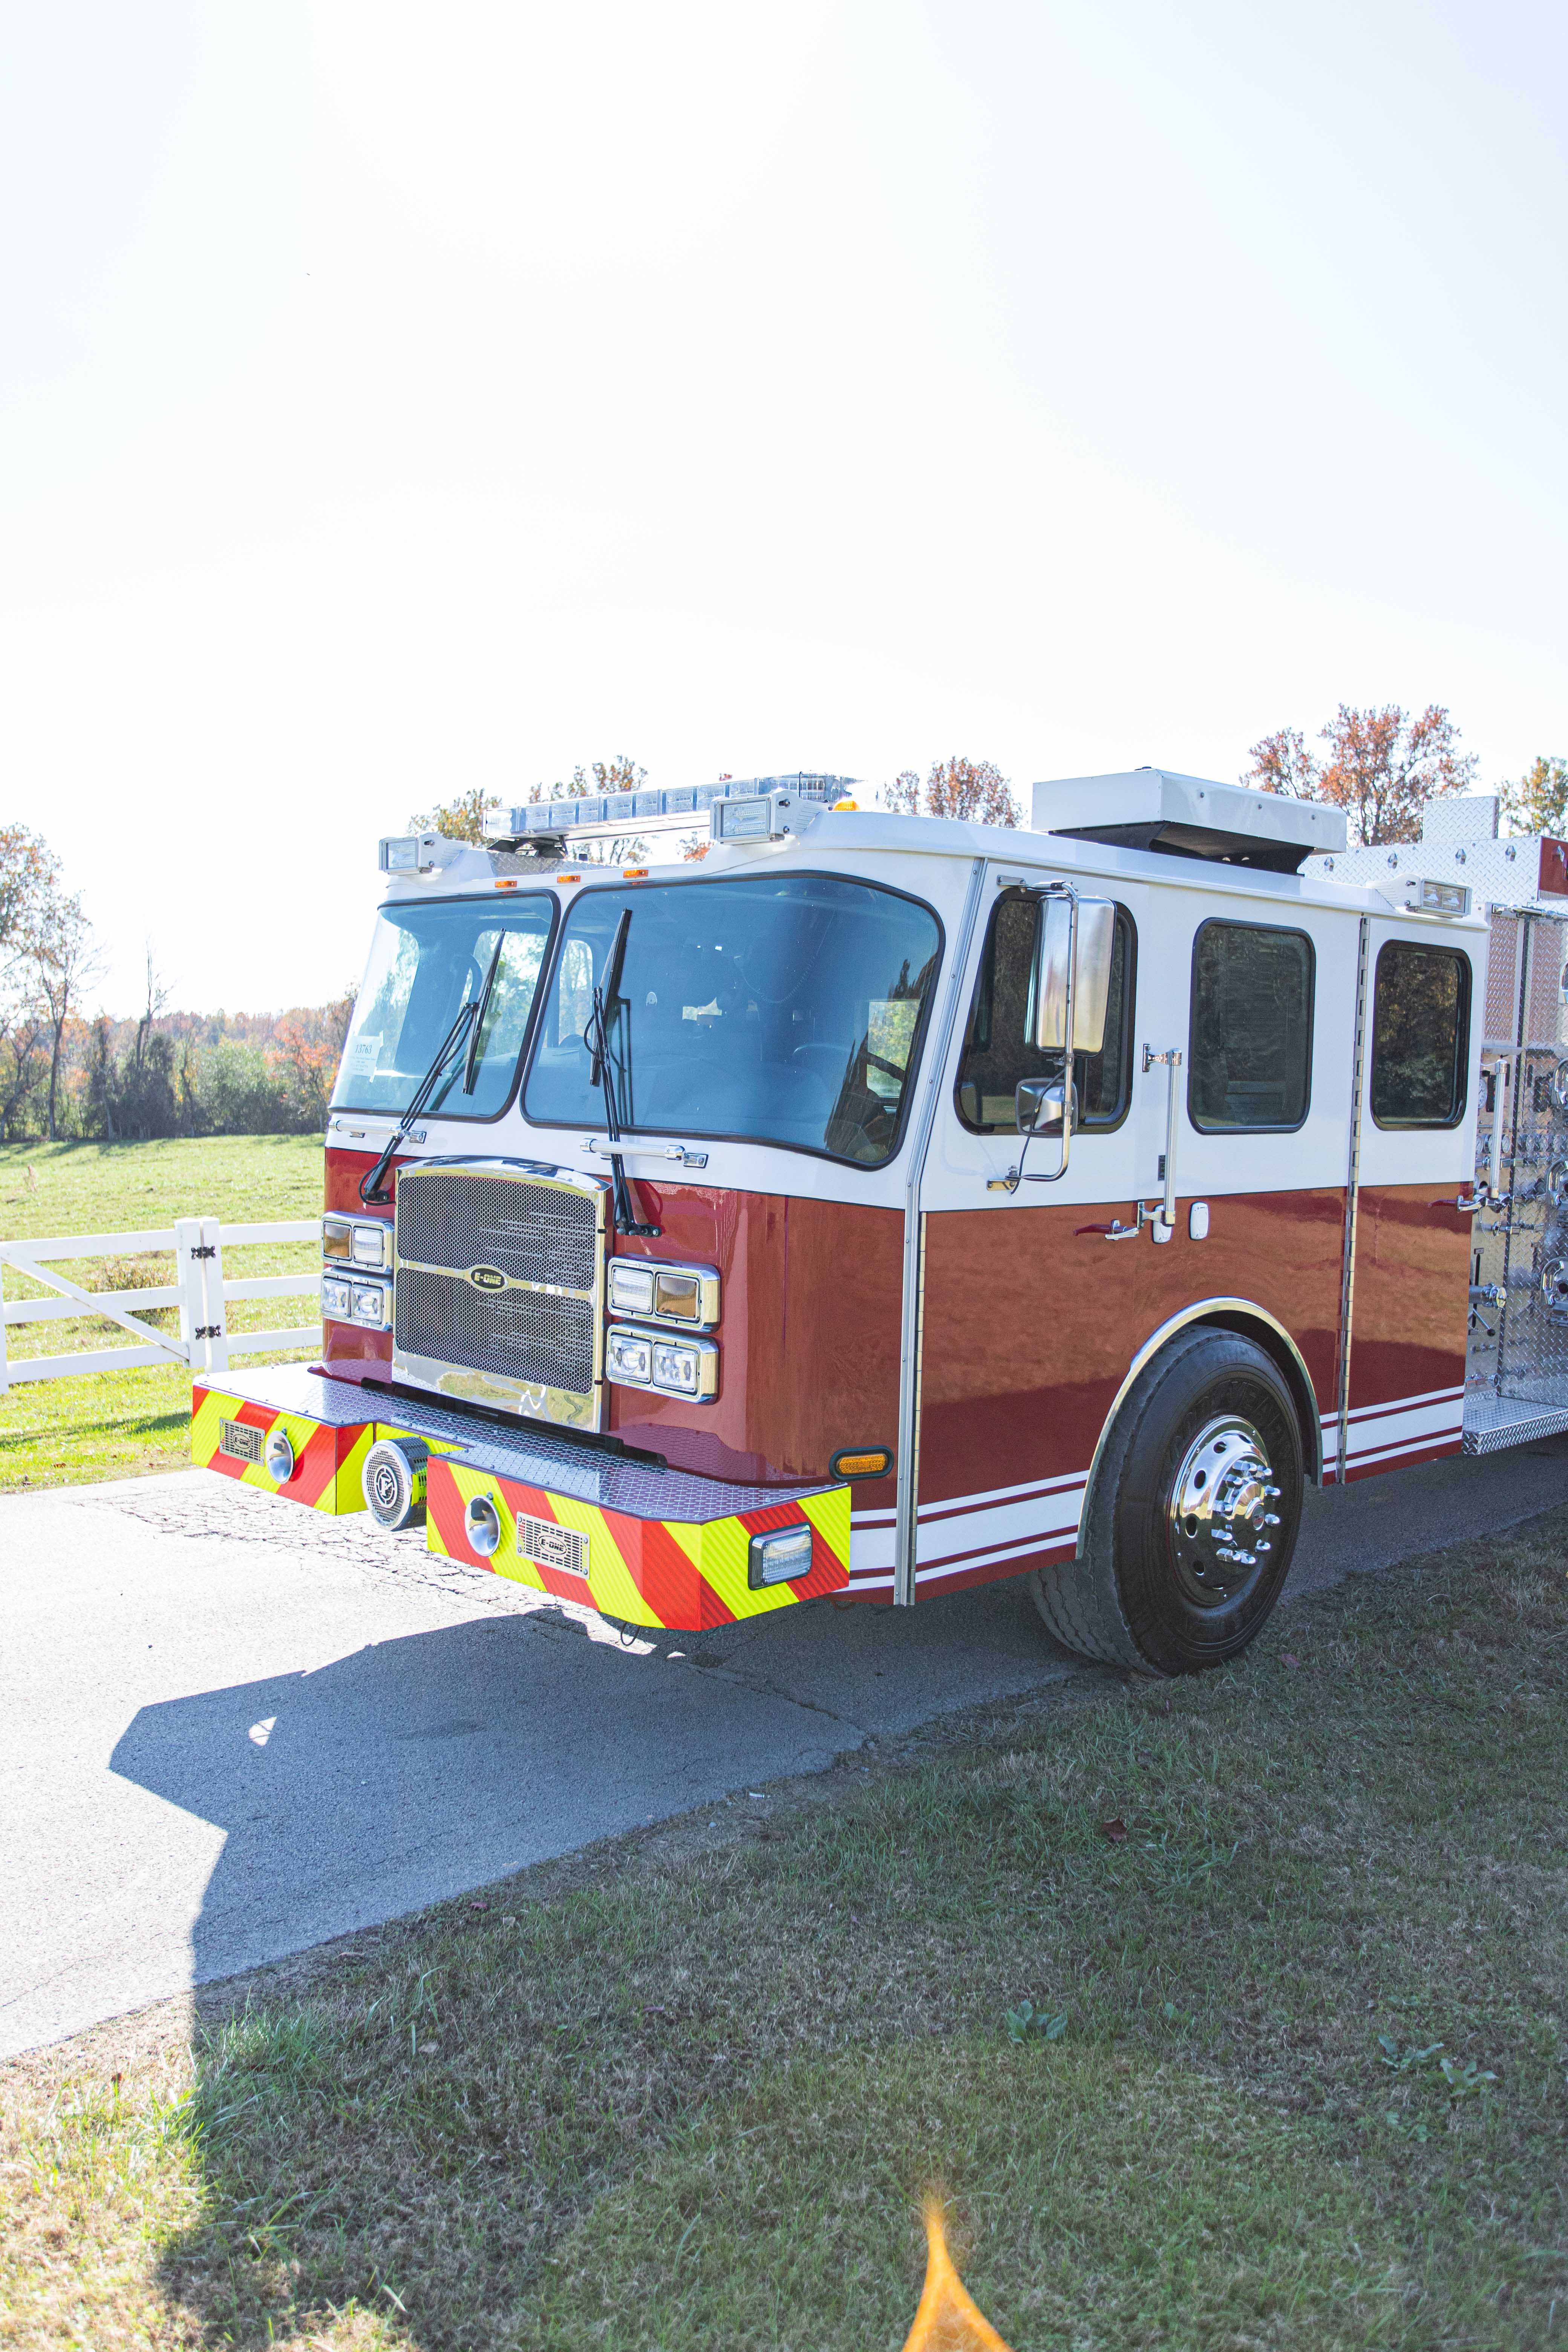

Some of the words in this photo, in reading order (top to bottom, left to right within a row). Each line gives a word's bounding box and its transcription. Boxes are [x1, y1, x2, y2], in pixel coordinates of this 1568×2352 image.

[355, 1044, 372, 1054] 13763
[475, 1272, 501, 1285] E-ONE
[235, 1437, 249, 1446] E-ONE
[541, 1539, 564, 1551] E-ONE
